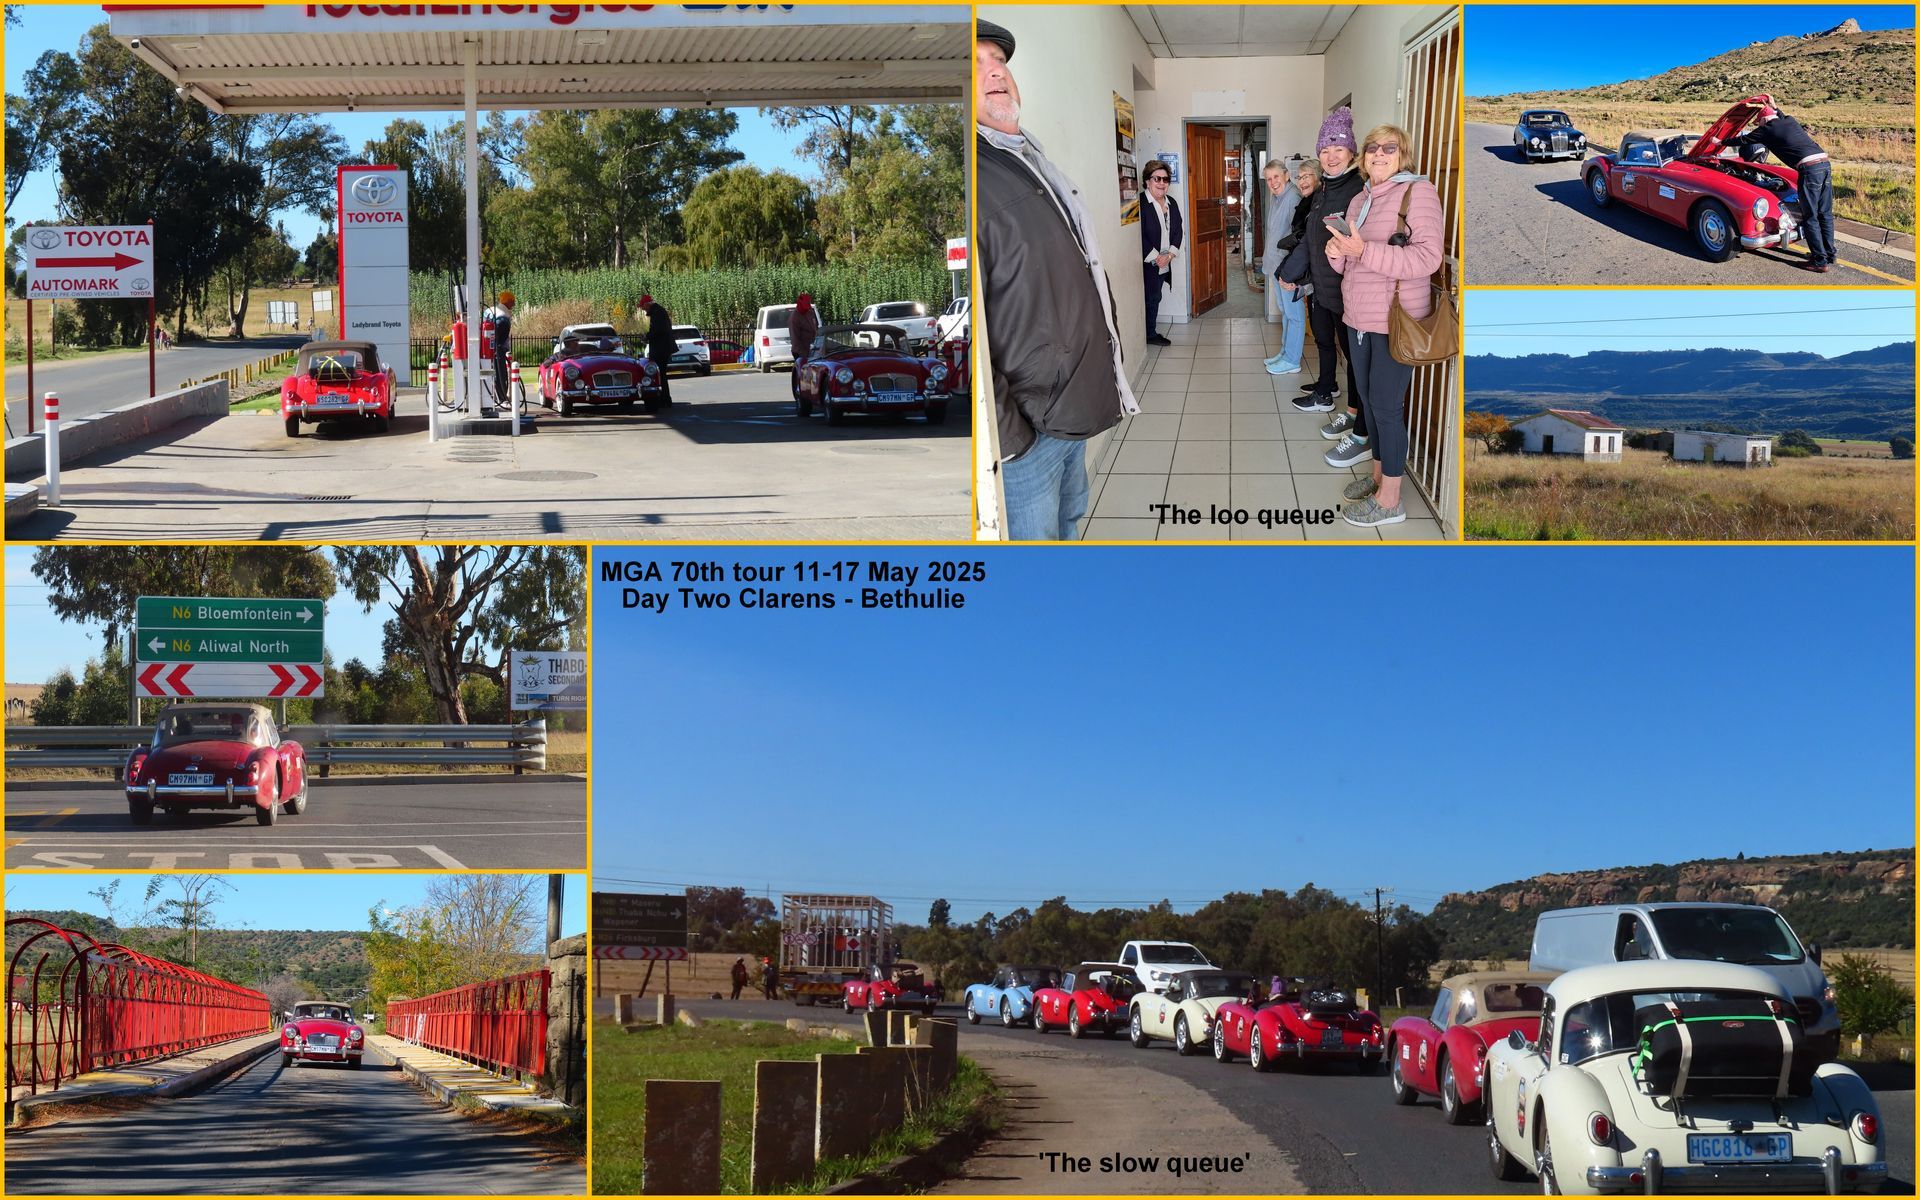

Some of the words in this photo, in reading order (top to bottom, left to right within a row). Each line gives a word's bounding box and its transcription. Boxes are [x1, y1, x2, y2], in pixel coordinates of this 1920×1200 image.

[347, 212, 403, 223] TOYOTA
[64, 230, 150, 247] TOYOTA
[31, 279, 119, 291] AUTOMARK
[352, 321, 381, 329] Ladybrand
[172, 606, 191, 619] N6
[198, 606, 292, 620] Bloemfontein
[172, 639, 191, 653] N6
[199, 640, 243, 653] Aliwal
[250, 641, 289, 653] North
[169, 774, 198, 784] CM97MN
[203, 774, 213, 784] GP
[1691, 1138, 1753, 1158] HGC816
[1767, 1137, 1788, 1157] GP
